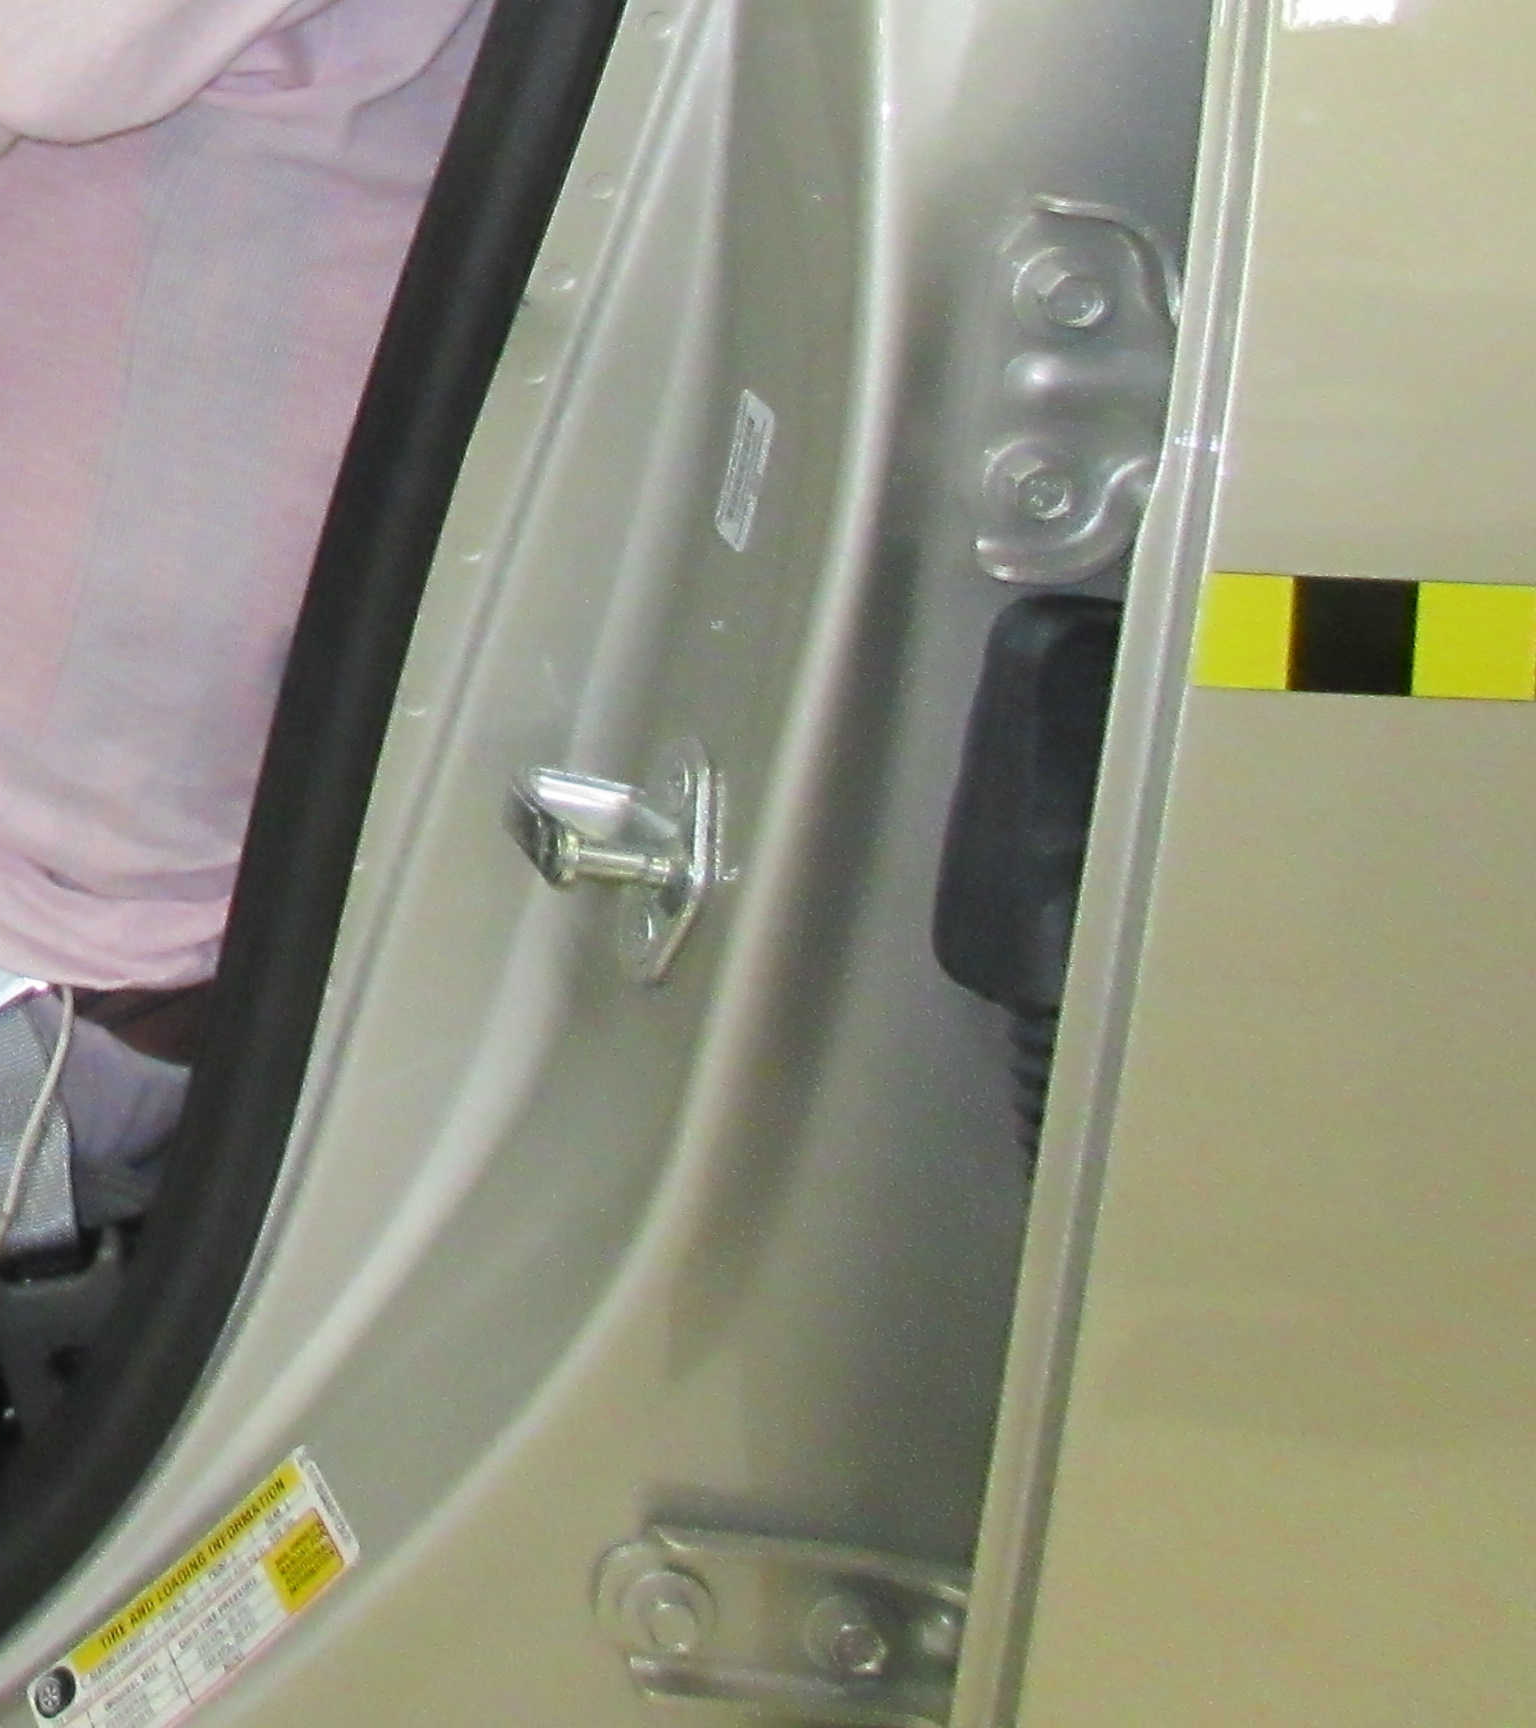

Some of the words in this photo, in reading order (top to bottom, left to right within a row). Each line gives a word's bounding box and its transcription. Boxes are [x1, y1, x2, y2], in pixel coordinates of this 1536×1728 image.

[100, 1622, 127, 1650] TIRE
[128, 1598, 155, 1629] AND
[156, 1551, 207, 1603] LOADING
[208, 1478, 285, 1557] INFORMATION
